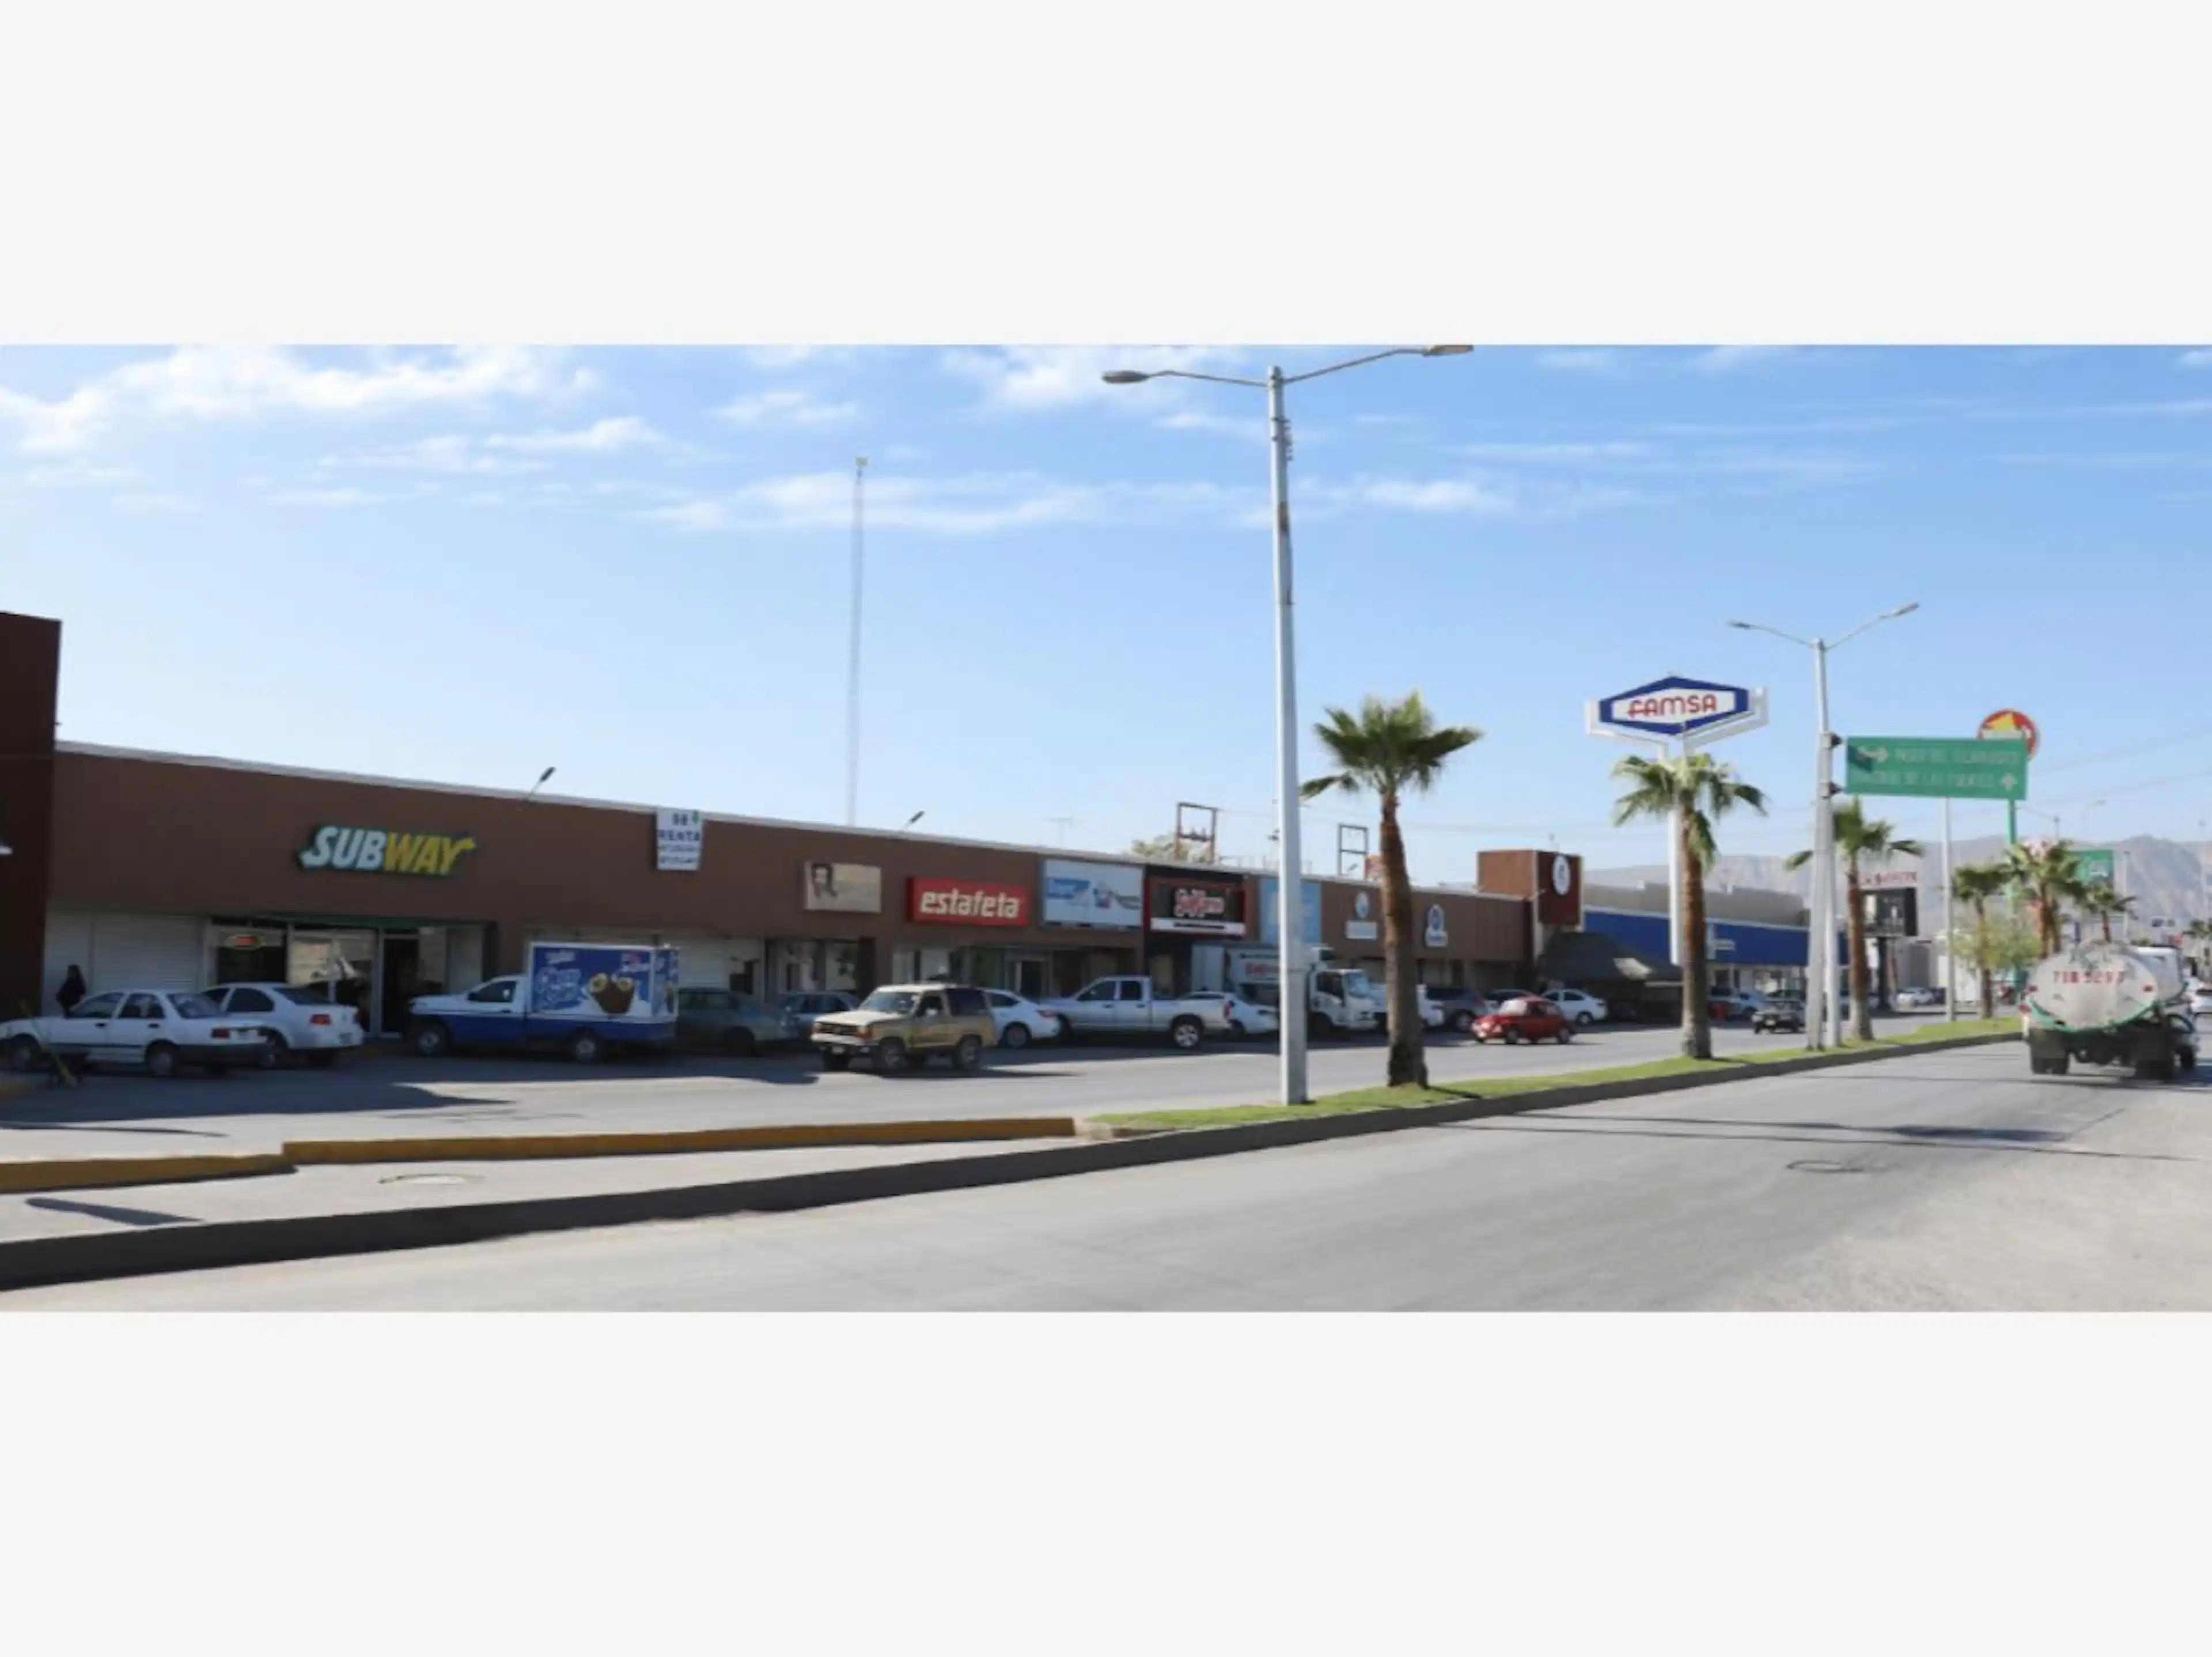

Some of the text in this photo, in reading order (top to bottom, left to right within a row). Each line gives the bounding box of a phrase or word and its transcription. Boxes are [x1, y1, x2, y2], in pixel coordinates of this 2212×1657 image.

[1628, 693, 1717, 718] FAMSA
[300, 825, 475, 876] SUBWAY
[920, 888, 1020, 919] estafeta
